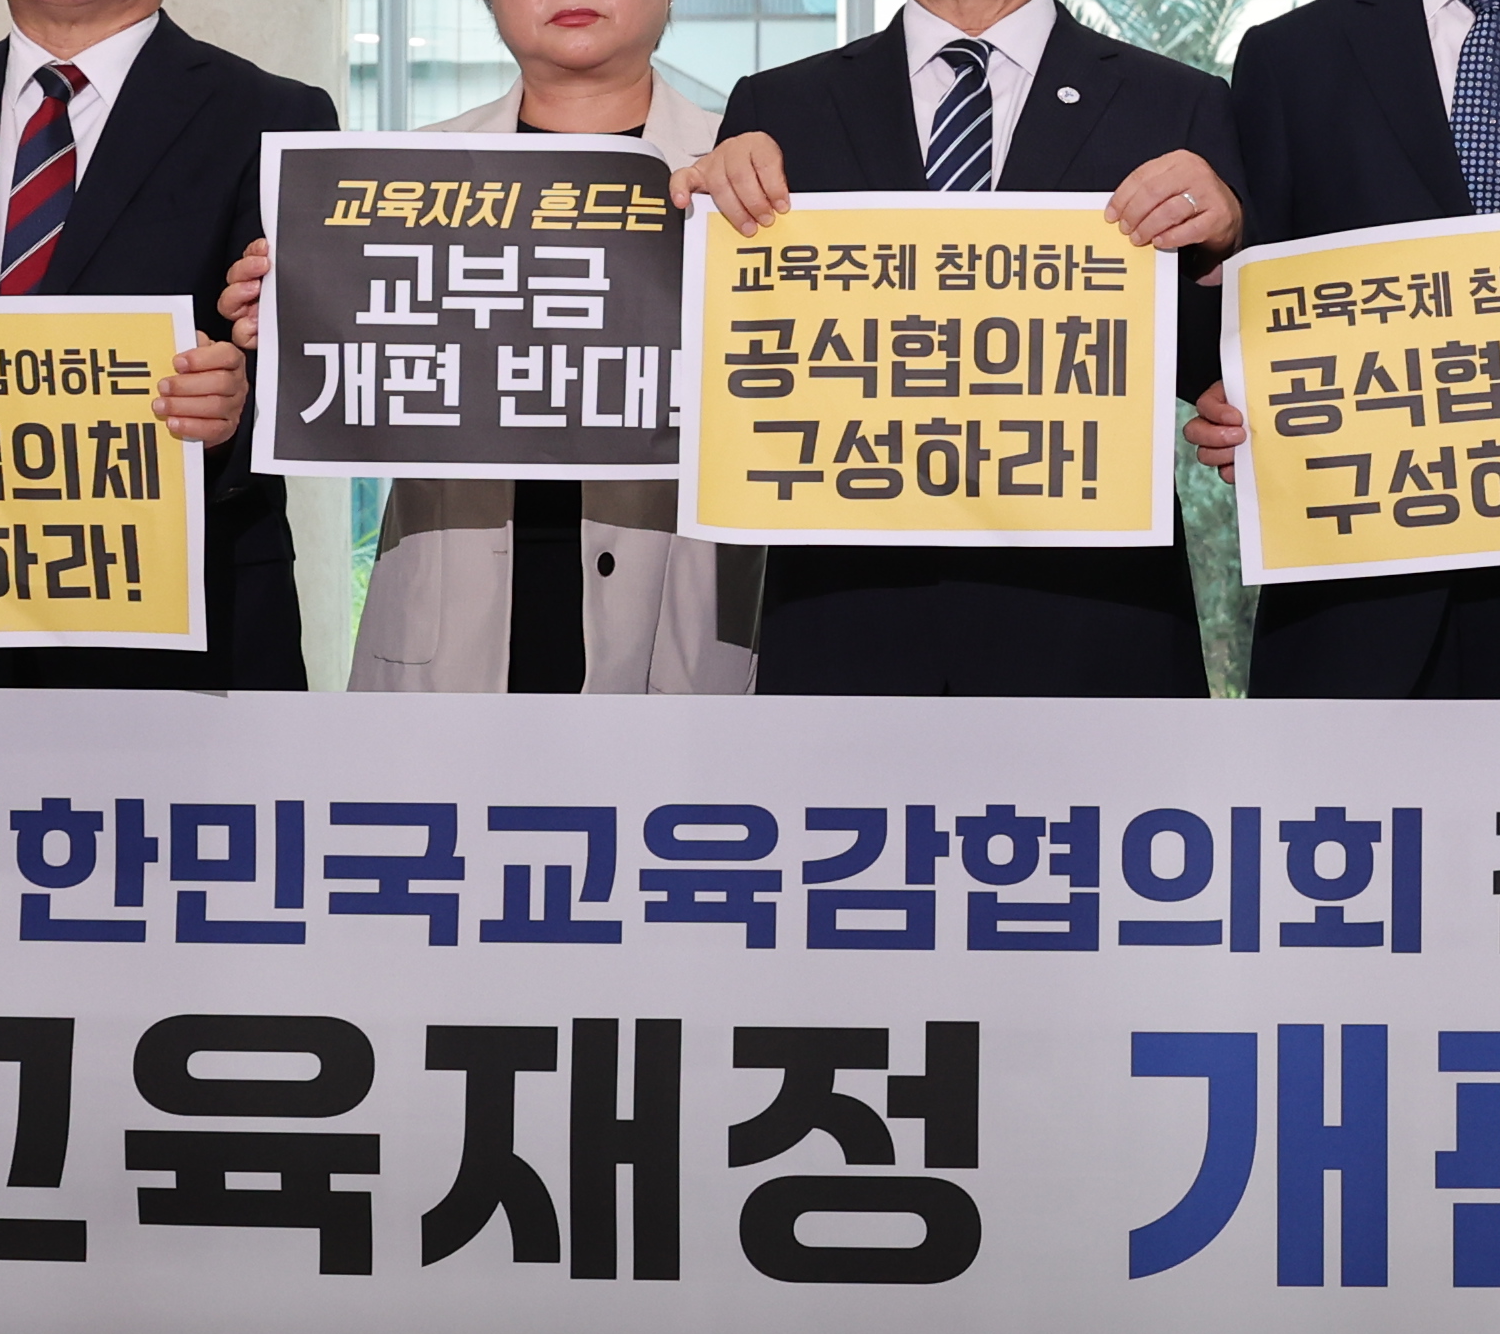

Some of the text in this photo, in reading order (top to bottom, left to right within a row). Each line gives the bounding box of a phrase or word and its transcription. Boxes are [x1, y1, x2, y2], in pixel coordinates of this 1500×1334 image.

[324, 179, 667, 232] 교육자치 흔드는
[355, 243, 611, 330] 교부금
[731, 243, 1128, 293] 교육주체 참여하는
[1265, 270, 1453, 334] 교육주체
[299, 342, 461, 427] 개편
[724, 314, 1128, 399] 공식협의체
[746, 417, 1098, 501] 구성하라!
